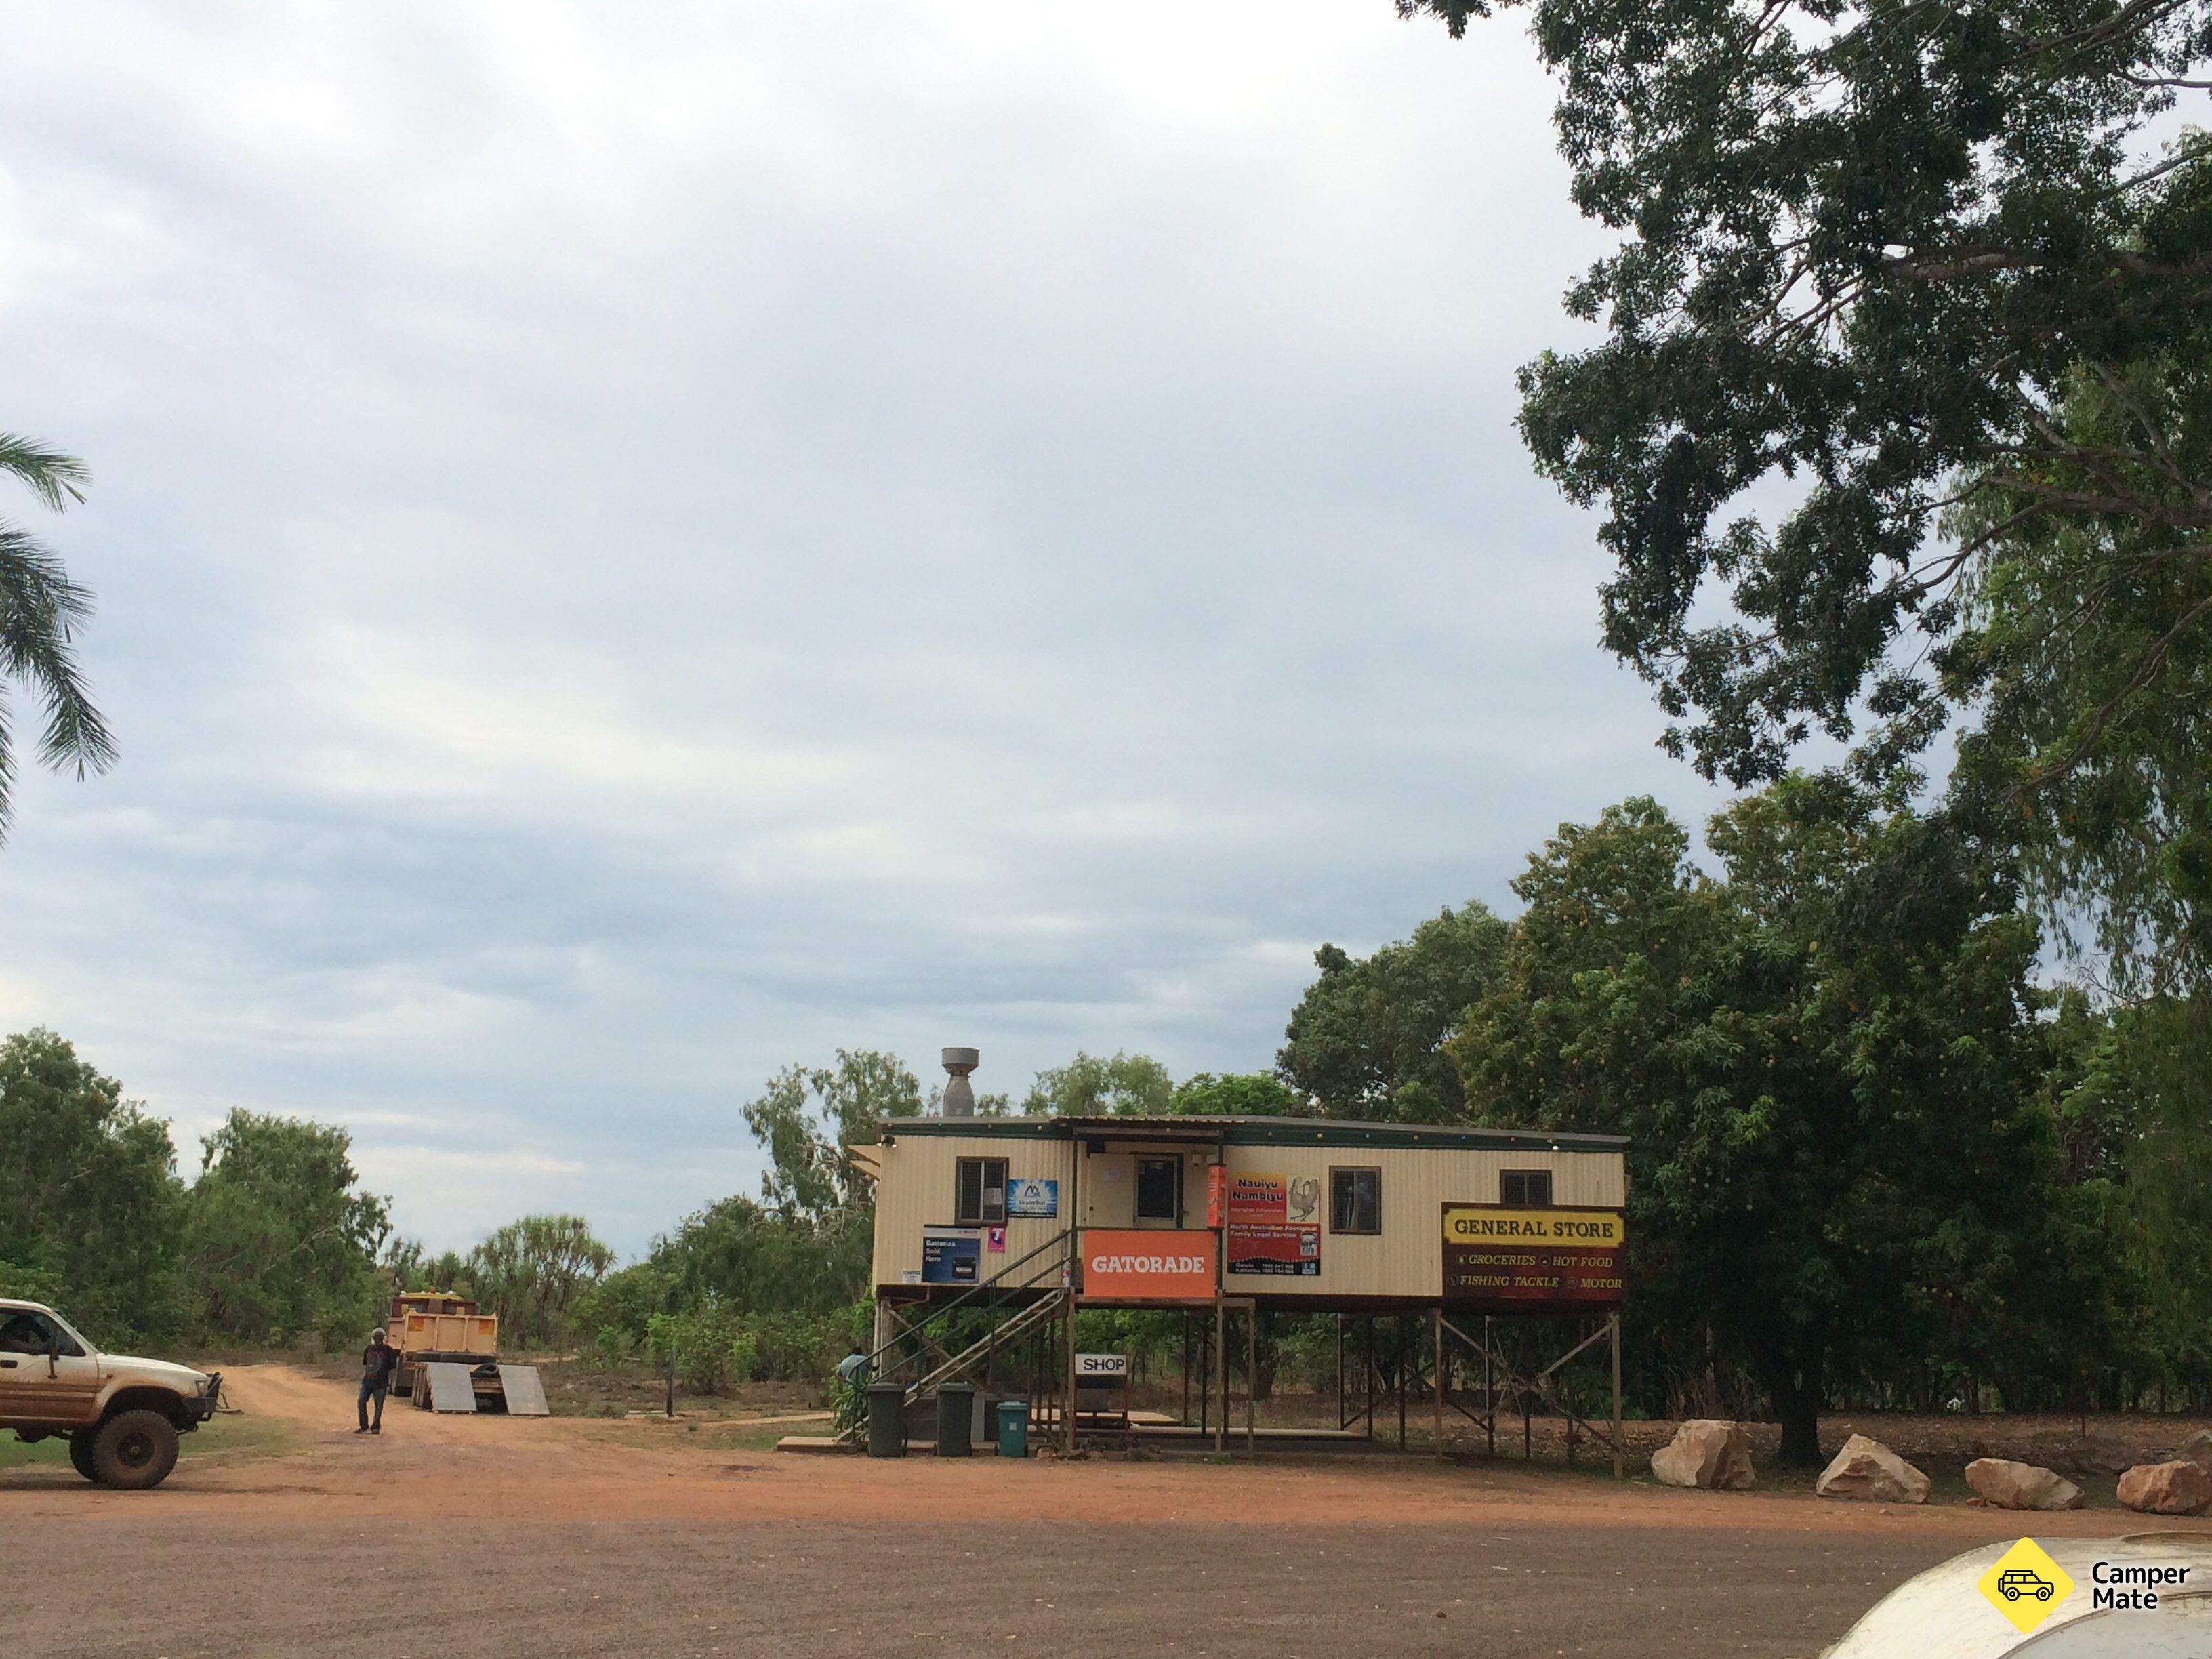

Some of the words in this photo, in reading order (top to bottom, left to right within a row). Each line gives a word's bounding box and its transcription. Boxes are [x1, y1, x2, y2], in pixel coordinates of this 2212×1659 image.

[1238, 1179, 1278, 1189] Nauiyu
[1233, 1191, 1283, 1202] Nambiyu
[1454, 1219, 1547, 1236] GENERAL
[1553, 1222, 1613, 1237] STORE
[1092, 1256, 1205, 1273] GATORADE
[1469, 1254, 1536, 1265] GROCERIES
[1552, 1256, 1576, 1266] HOT
[1580, 1257, 1613, 1267] FOOD
[1460, 1275, 1509, 1286] FISHING
[1514, 1277, 1559, 1287] TACKLE
[1580, 1278, 1622, 1288] MOTOR
[1084, 1359, 1124, 1370] SHOP
